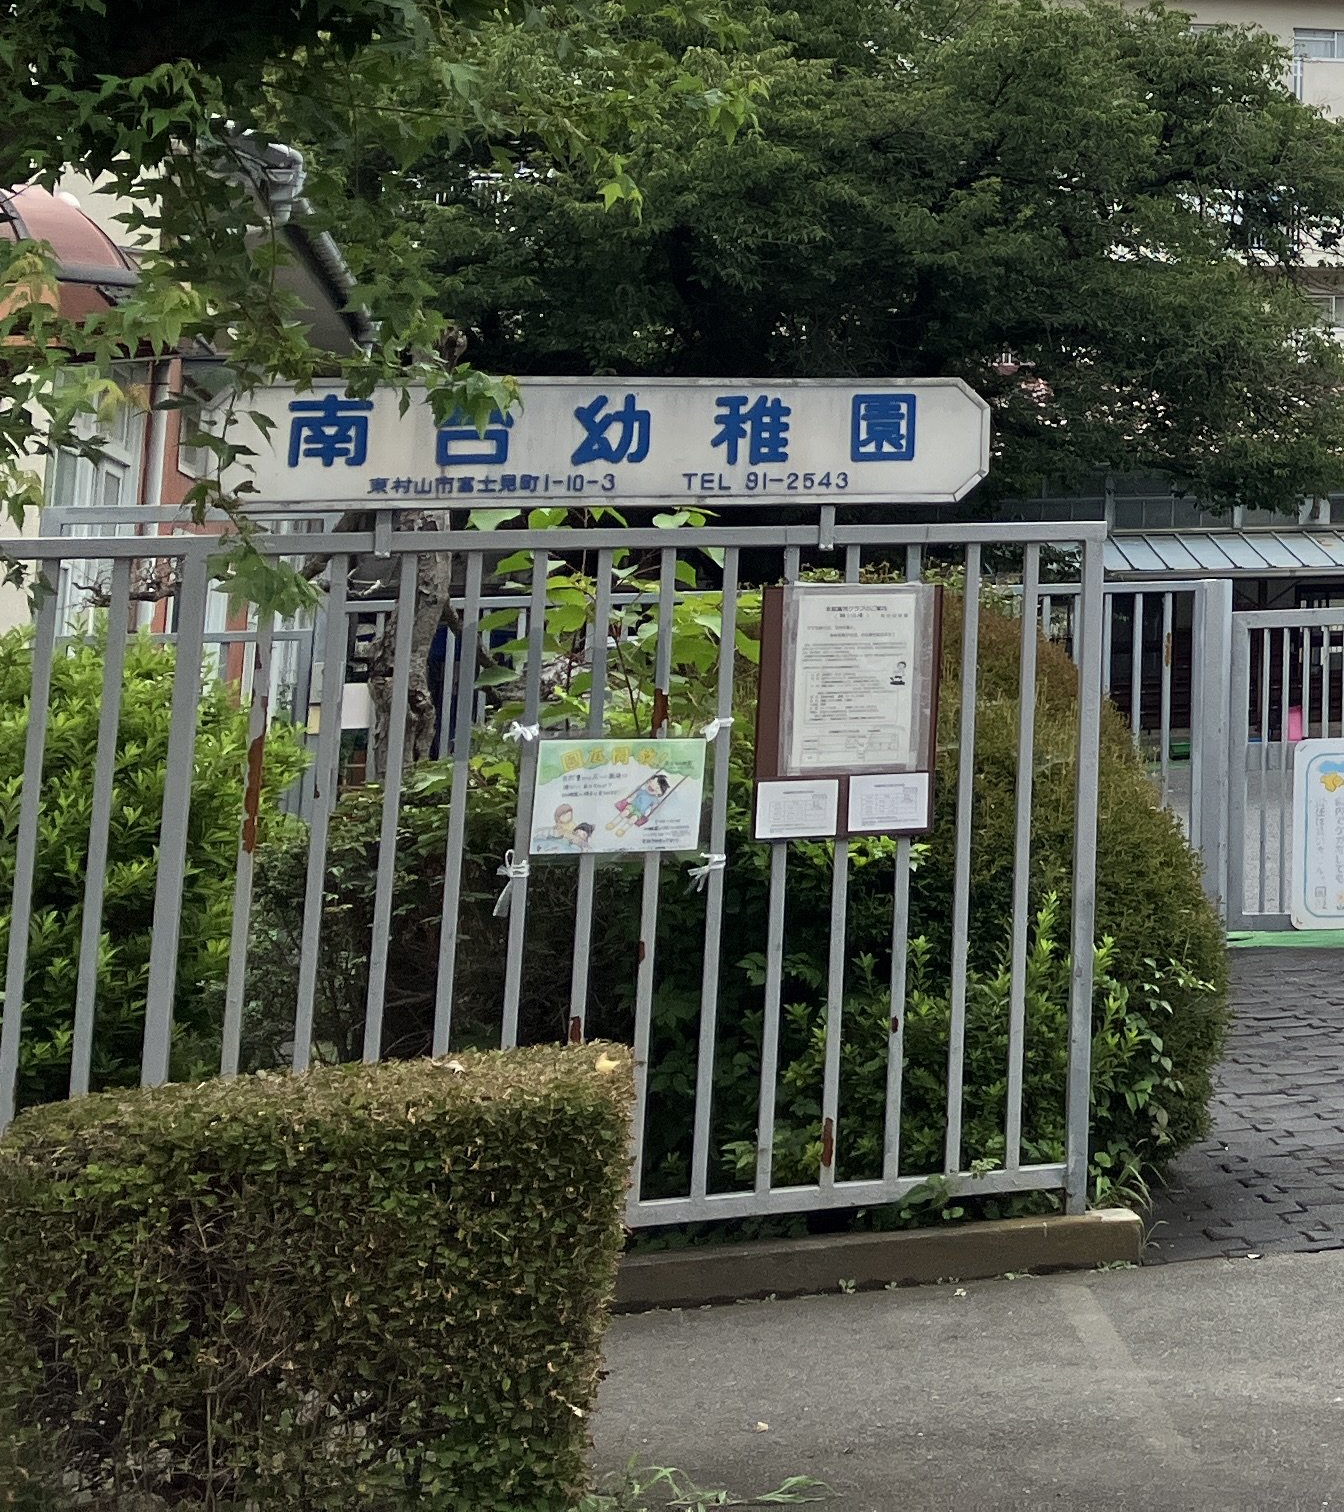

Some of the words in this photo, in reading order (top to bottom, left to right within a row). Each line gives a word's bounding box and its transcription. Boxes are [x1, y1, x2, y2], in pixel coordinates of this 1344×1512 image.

[288, 393, 916, 467] 南台幼稚園
[683, 473, 731, 489] TEL
[746, 471, 849, 489] 91-2543
